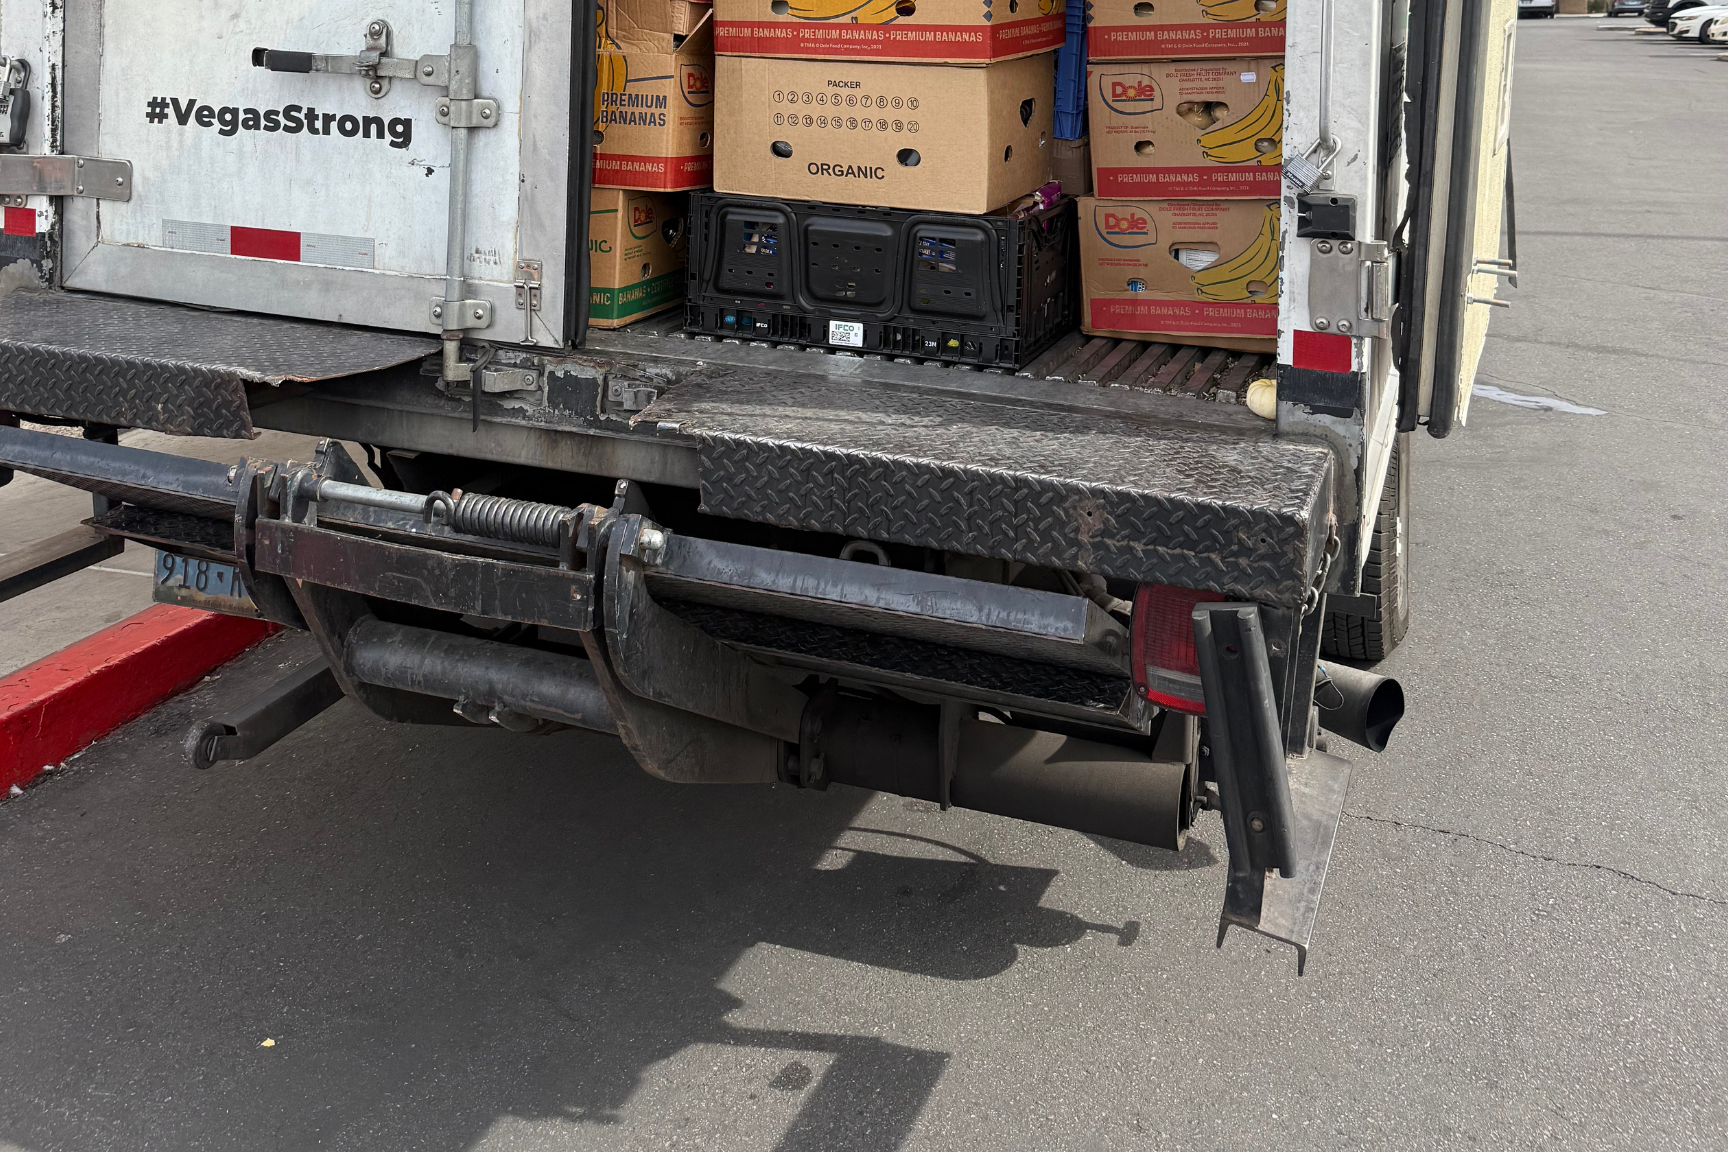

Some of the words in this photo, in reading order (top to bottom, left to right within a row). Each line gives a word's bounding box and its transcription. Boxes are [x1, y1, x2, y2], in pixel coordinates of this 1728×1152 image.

[714, 27, 751, 37] PREMIUM
[753, 28, 792, 38] BANANAS
[799, 29, 840, 40] PREMIUM
[841, 29, 884, 40] BANANAS
[890, 31, 934, 42] PREMIUM
[935, 32, 983, 42] BANANAS
[1000, 27, 1020, 40] PREMIUM
[1111, 31, 1155, 42] PREMIUM
[1157, 30, 1202, 40] BANANAS
[1209, 28, 1256, 39] PREMIUM
[686, 72, 709, 91] Dole
[827, 79, 861, 89] PACKER
[1111, 81, 1155, 98] Dole
[601, 91, 667, 110] PREMIUM
[145, 95, 413, 149] #VegasStrong
[600, 109, 666, 127] BANANAS
[622, 161, 665, 173] BANANAS
[807, 162, 885, 180] ORGANIC
[1117, 174, 1156, 183] PREMIUM
[1158, 173, 1199, 182] BANANAS
[1212, 172, 1253, 182] PREMIUM
[633, 205, 653, 225] Dole
[1104, 213, 1147, 232] Dole
[1110, 305, 1148, 315] PREMIUM
[1150, 306, 1190, 316] BANANAS
[1204, 308, 1245, 318] PREMIUM
[834, 324, 855, 332] IFCO
[924, 340, 937, 348] 23N
[160, 553, 209, 592] 918
